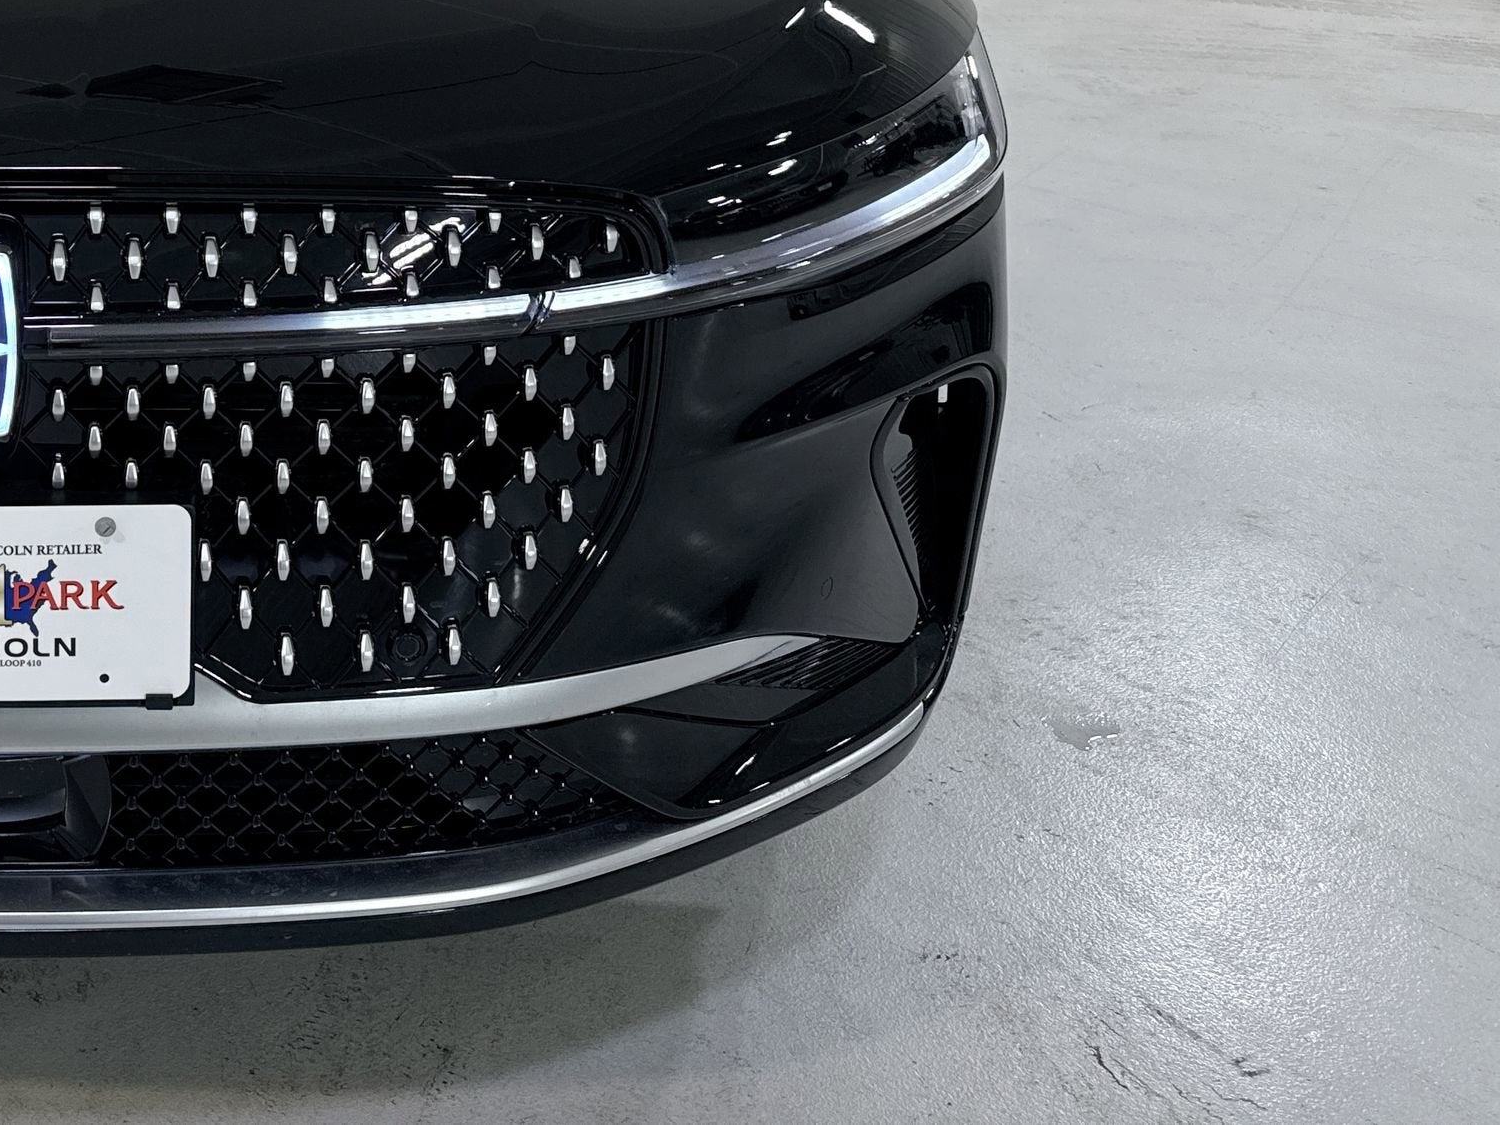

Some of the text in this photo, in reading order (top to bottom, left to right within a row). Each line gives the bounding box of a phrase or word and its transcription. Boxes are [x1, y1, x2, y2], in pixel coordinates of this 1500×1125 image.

[36, 543, 103, 556] RETAILER
[11, 579, 125, 611] PARK
[0, 659, 26, 668] LOOP
[27, 659, 42, 668] 410
